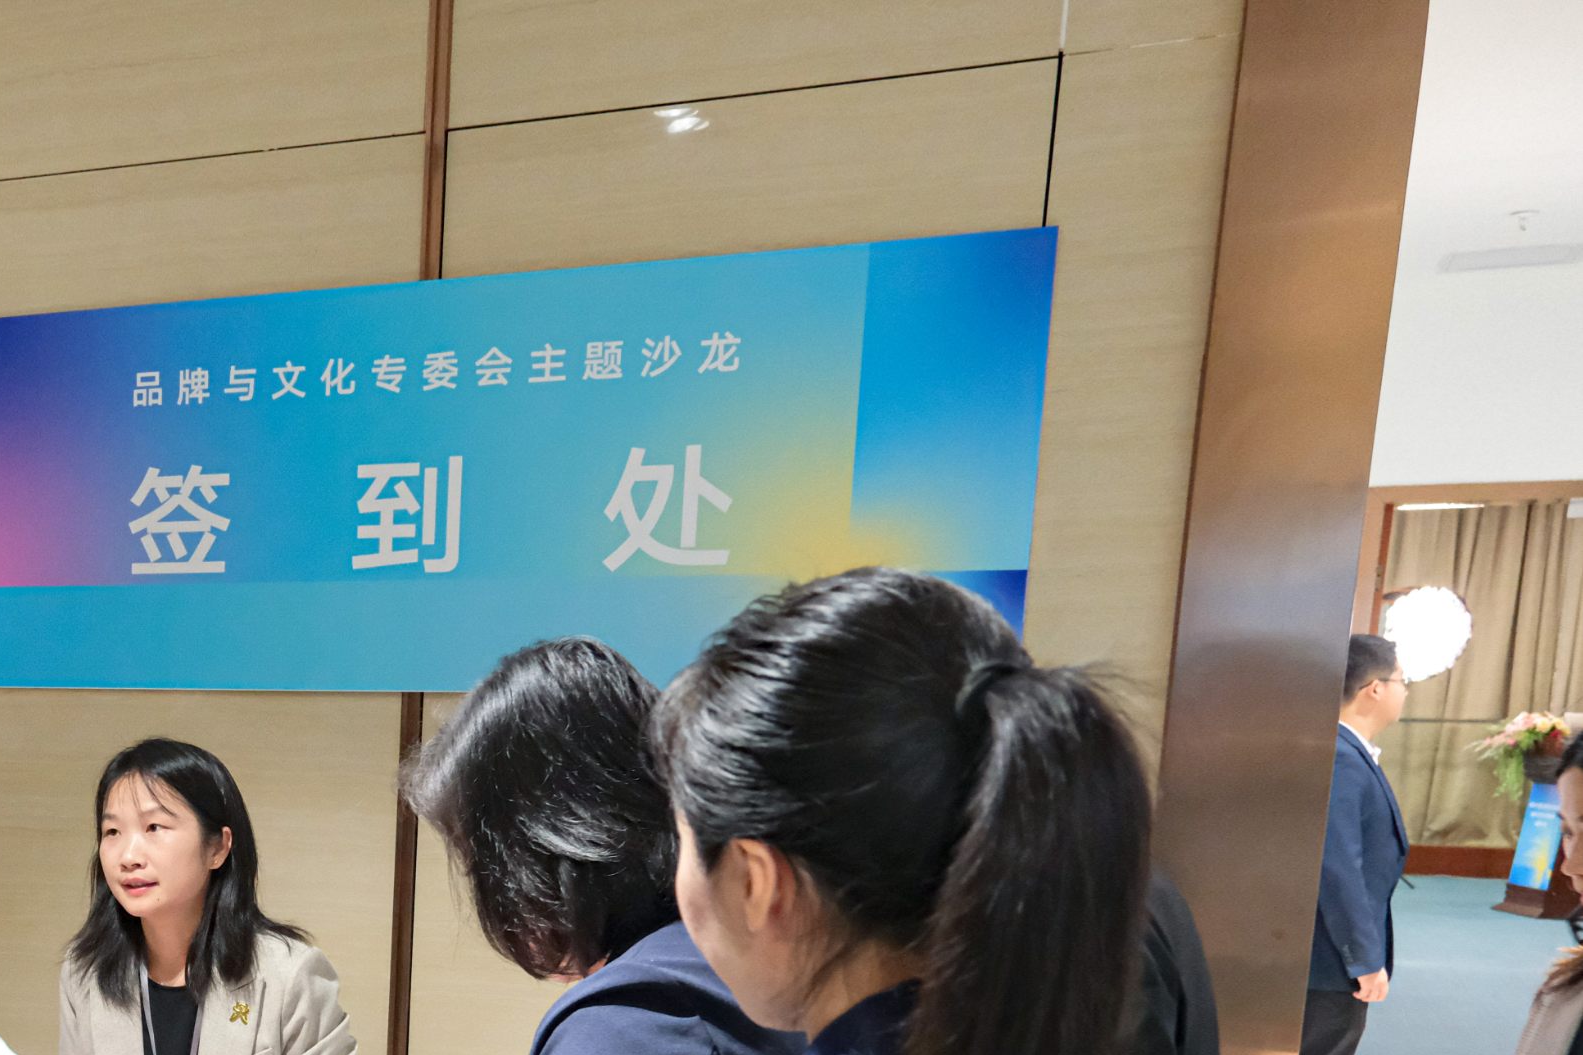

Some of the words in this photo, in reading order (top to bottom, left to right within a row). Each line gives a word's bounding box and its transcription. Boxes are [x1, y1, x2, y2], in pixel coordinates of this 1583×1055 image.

[131, 330, 743, 408] 品牌与文化专委会主题沙龙
[127, 443, 734, 575] 签到处
